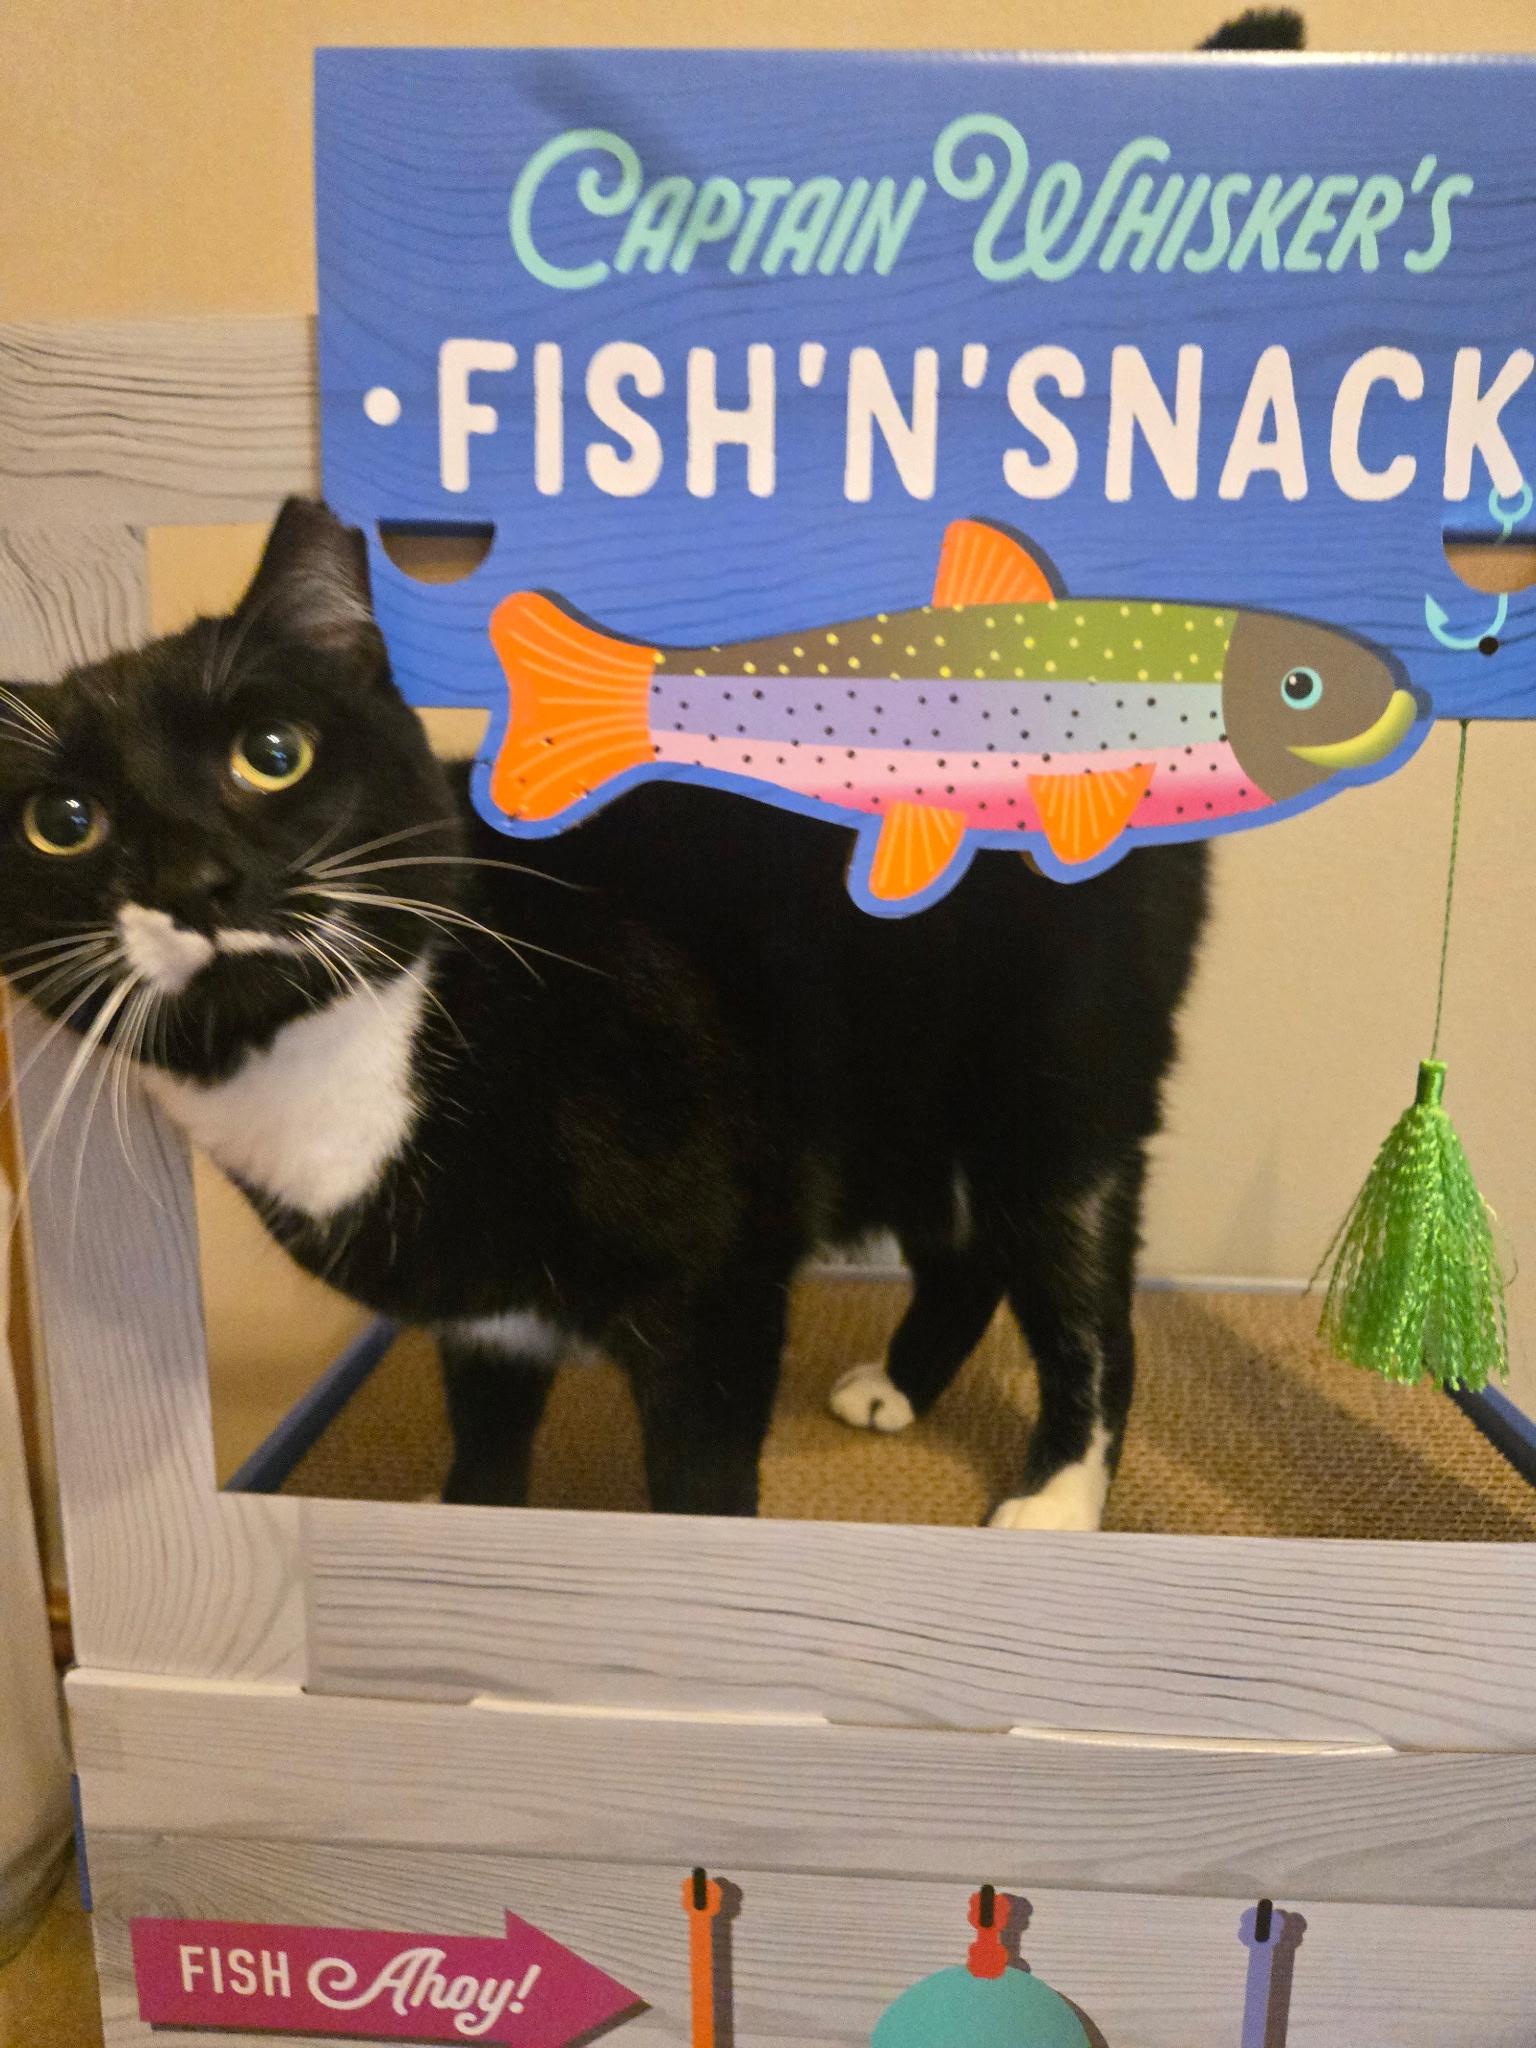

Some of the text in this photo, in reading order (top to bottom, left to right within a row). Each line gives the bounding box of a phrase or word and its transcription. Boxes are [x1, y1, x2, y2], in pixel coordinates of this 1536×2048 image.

[509, 113, 1474, 289] CAPTAIN WHISKER'S
[179, 1944, 542, 2036] FISH Ahoy!
